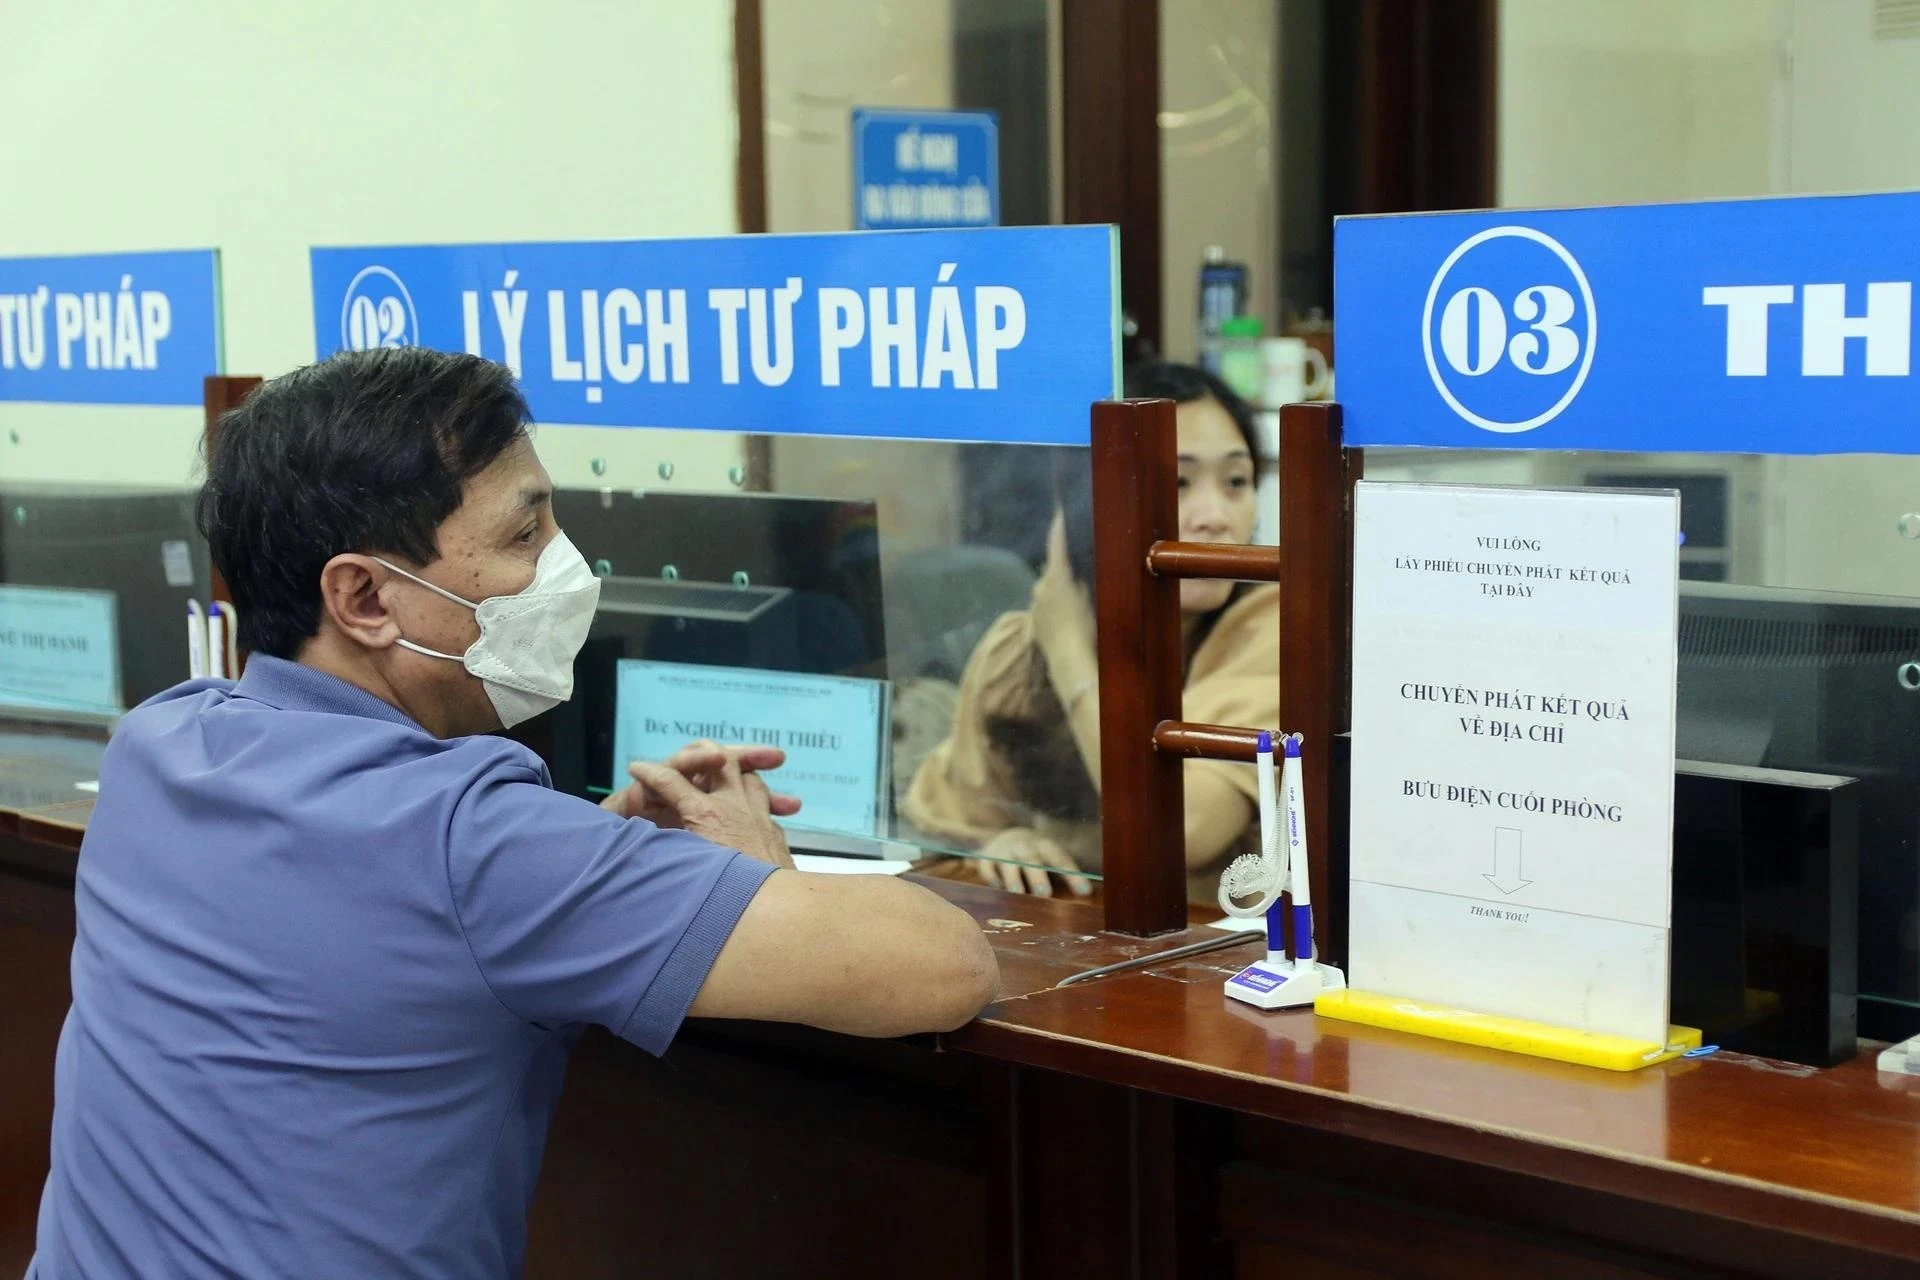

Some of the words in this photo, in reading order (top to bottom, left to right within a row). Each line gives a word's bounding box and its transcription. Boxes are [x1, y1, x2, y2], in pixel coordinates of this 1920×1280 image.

[0, 285, 49, 370] TƯ
[55, 274, 172, 370] PHÁP
[547, 288, 690, 403] LỊCH
[708, 277, 803, 387] TƯ
[818, 262, 1026, 390] PHÁP
[1440, 284, 1580, 376] 03
[1476, 536, 1500, 549] VUI
[1503, 535, 1541, 551] LÒNG
[1526, 563, 1562, 579] PHÁT
[1569, 566, 1597, 582] KẾT
[1601, 568, 1631, 585] QUẢ
[1480, 582, 1502, 598] TẠI
[1506, 582, 1535, 598] ĐÂY
[1400, 683, 1479, 706] CHUYỂN
[1484, 688, 1536, 711] PHÁT
[1541, 693, 1581, 716] KẾT
[1586, 699, 1630, 722] QUẢ
[1489, 720, 1523, 742] ĐỊA
[1528, 722, 1565, 744] CHỈ
[1402, 780, 1442, 799] BƯU
[1446, 784, 1492, 808] ĐIỆN
[1497, 790, 1545, 813] CUỐI
[1551, 797, 1623, 823] PHÒNG
[1470, 906, 1503, 919] THANK
[1505, 911, 1530, 923] YOU!
